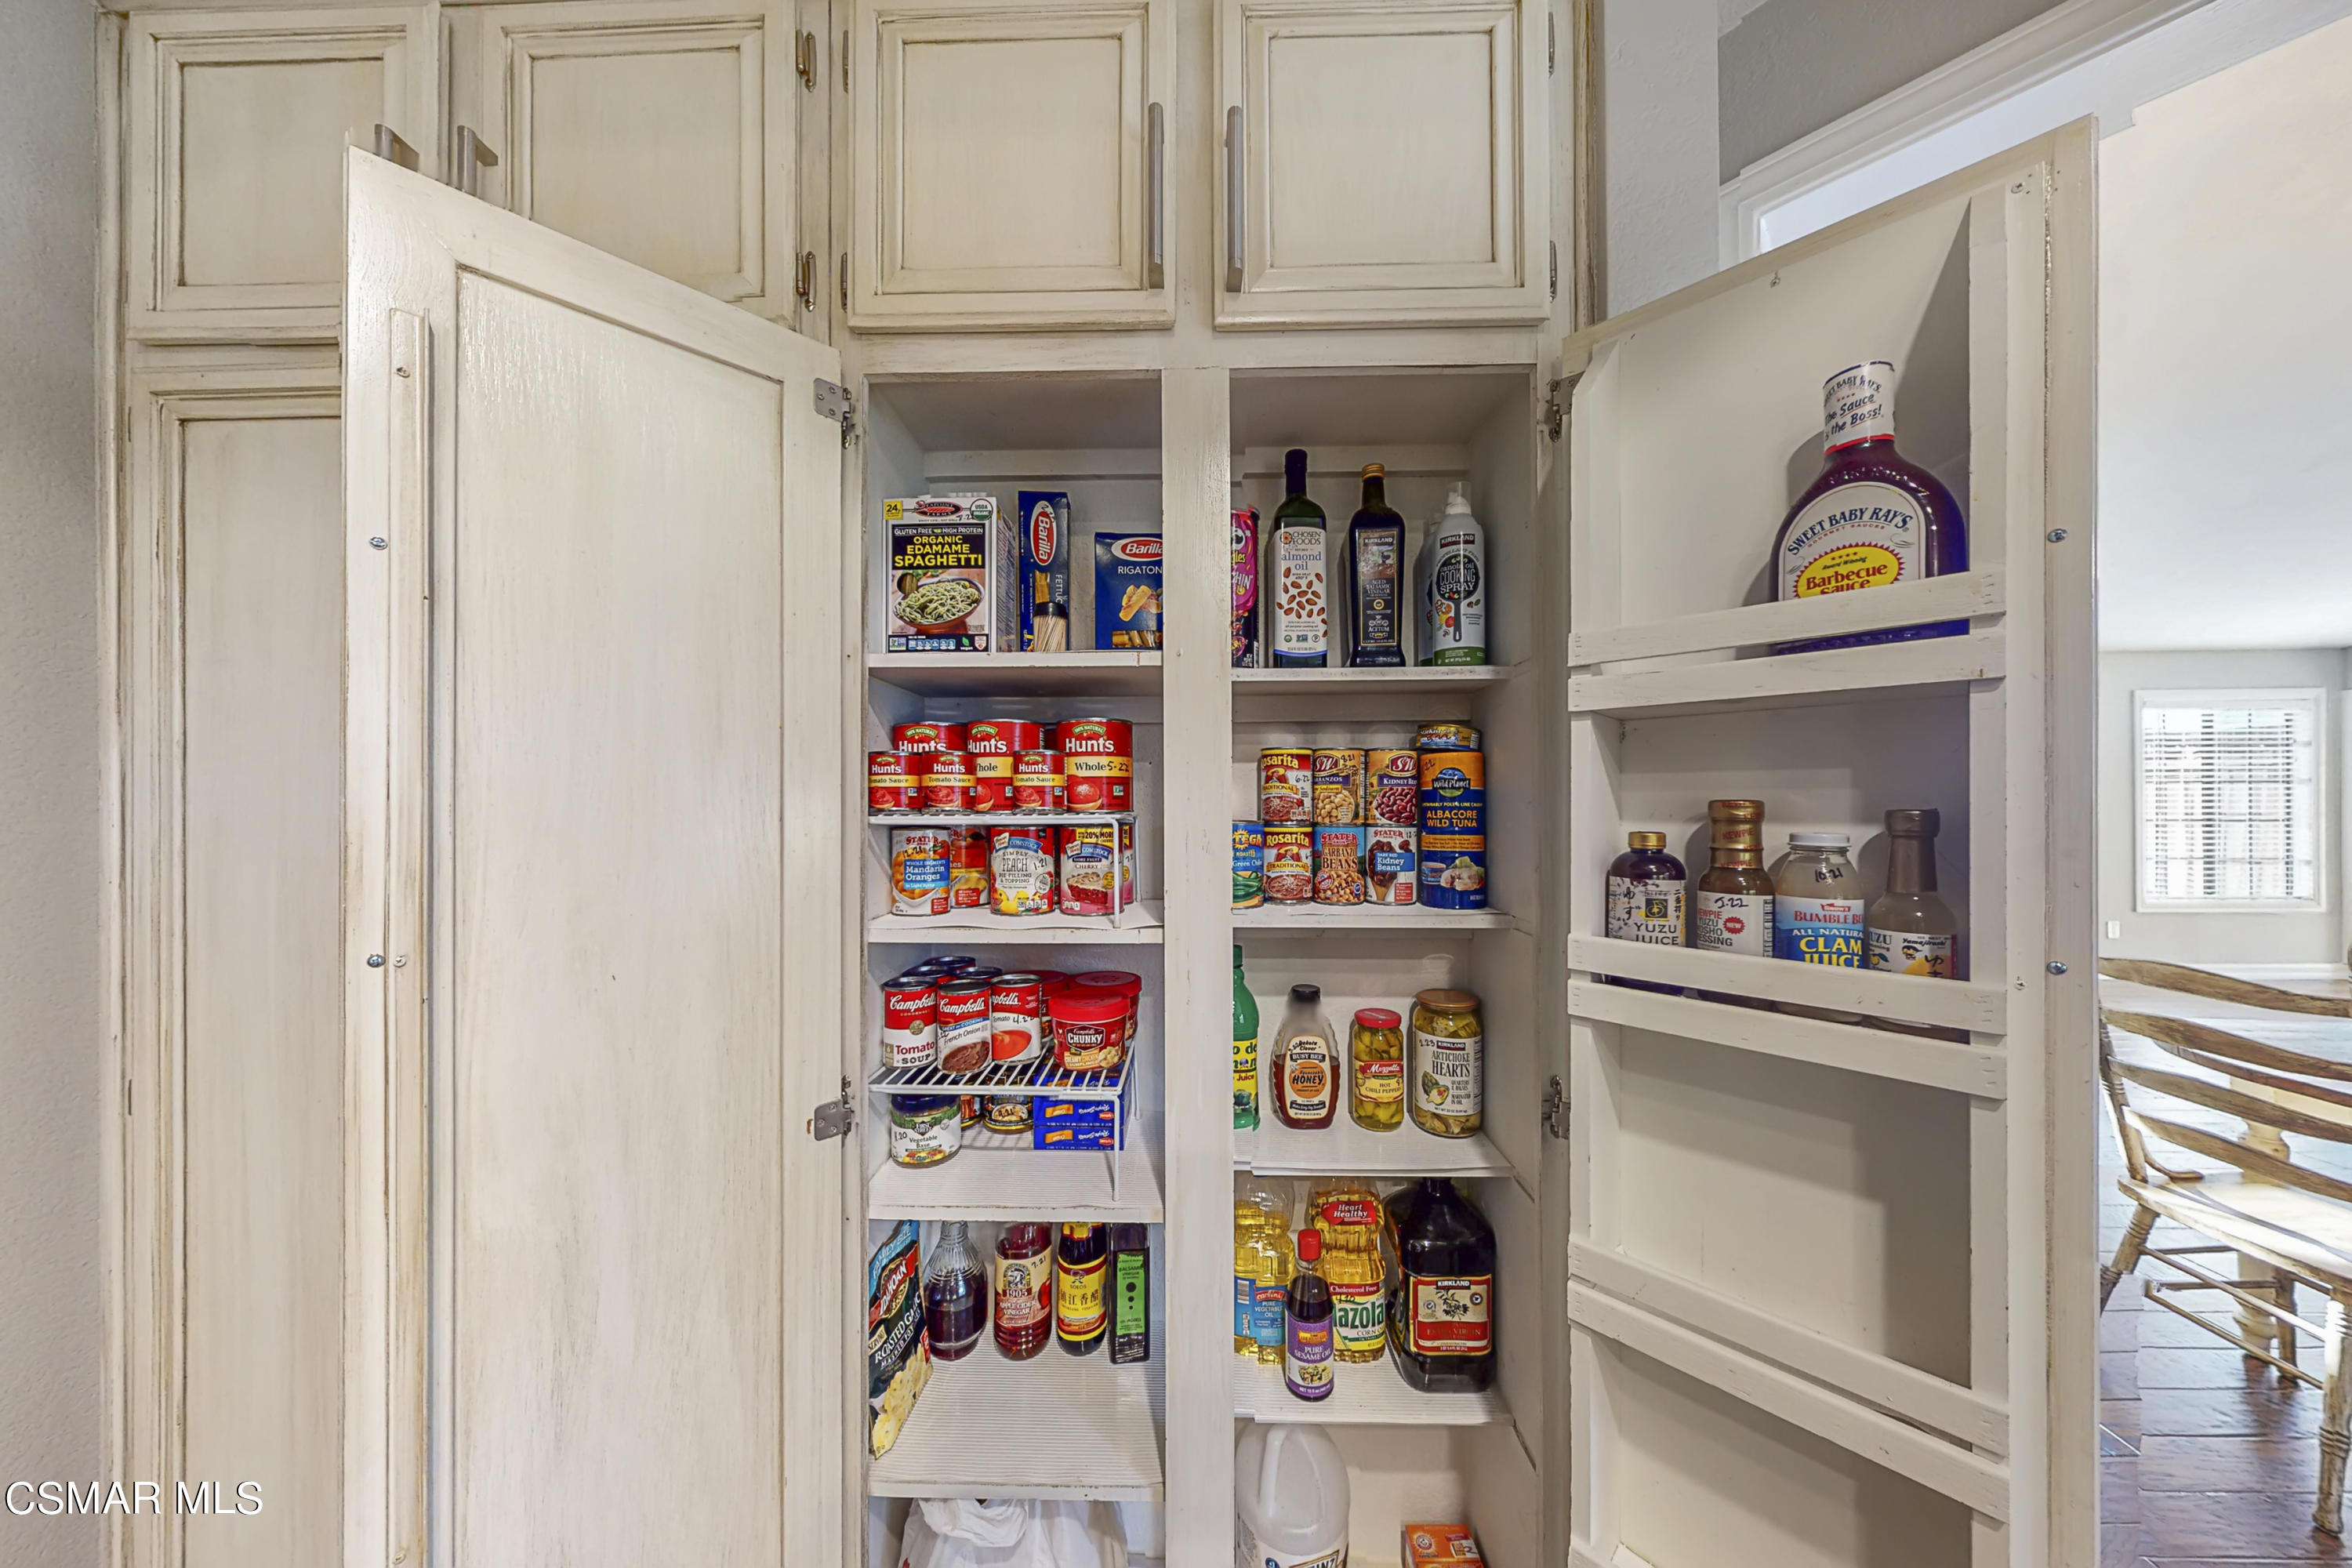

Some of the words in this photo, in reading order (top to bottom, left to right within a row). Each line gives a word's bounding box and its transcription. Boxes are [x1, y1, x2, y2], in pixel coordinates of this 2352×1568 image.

[1836, 376, 1857, 388] BABY
[1839, 394, 1875, 416] Sauce
[1831, 421, 1846, 435] the
[1850, 404, 1882, 425] Boss!
[1788, 519, 1828, 555] SWEET
[1828, 507, 1869, 527] BABY
[1869, 507, 1913, 529] RAY'S
[913, 535, 963, 544] ORGANIC
[1038, 516, 1051, 560] Barilla
[1441, 535, 1475, 544] KIRKLAND
[907, 544, 970, 554] EDAMAME
[895, 554, 982, 567] SPAGHETTI
[1281, 551, 1321, 561] almond
[1295, 561, 1308, 570] oil
[1439, 569, 1475, 585] COOKING
[1806, 564, 1888, 590] Barbecue
[1440, 583, 1475, 593] SPRAY
[979, 726, 996, 735] NATURAL
[1083, 724, 1104, 734] NATURAL
[1065, 738, 1114, 753] Hunt's
[1075, 762, 1106, 771] Whole
[1434, 779, 1448, 788] Wild
[1321, 833, 1357, 844] STATER
[1374, 829, 1403, 839] STATER
[1010, 840, 1037, 848] COMSTOCK
[1267, 833, 1309, 847] Rosarita
[1003, 858, 1028, 872] PEACH
[1323, 857, 1357, 869] BEANS
[1377, 857, 1404, 866] Kidney
[1699, 917, 1719, 927] YUZU
[1795, 910, 1849, 924] BUMBLE
[1634, 923, 1677, 934] YUZU
[1635, 935, 1679, 946] JUICE
[1800, 937, 1863, 955] CLAM
[940, 996, 985, 1015] Campbell's
[961, 1018, 983, 1027] COOKING
[944, 1033, 963, 1046] French
[963, 1027, 981, 1037] Onion
[1068, 1033, 1102, 1044] CHUNKY
[895, 1041, 935, 1054] Tomato
[902, 1054, 931, 1065] SOUP
[1432, 1051, 1470, 1062] ARTICHOKE
[1367, 1063, 1400, 1074] Mezzetta
[1432, 1061, 1470, 1077] HEARTS
[1293, 1074, 1323, 1085] HONEY
[909, 1134, 938, 1143] Vegetable
[1334, 1210, 1368, 1218] Healthy
[880, 1260, 907, 1316] IDAHOAN
[1330, 1285, 1364, 1294] Cholesterol
[875, 1321, 906, 1364] ROASTED
[1294, 1350, 1321, 1360] SESAME
[1322, 1348, 1330, 1358] OIL
